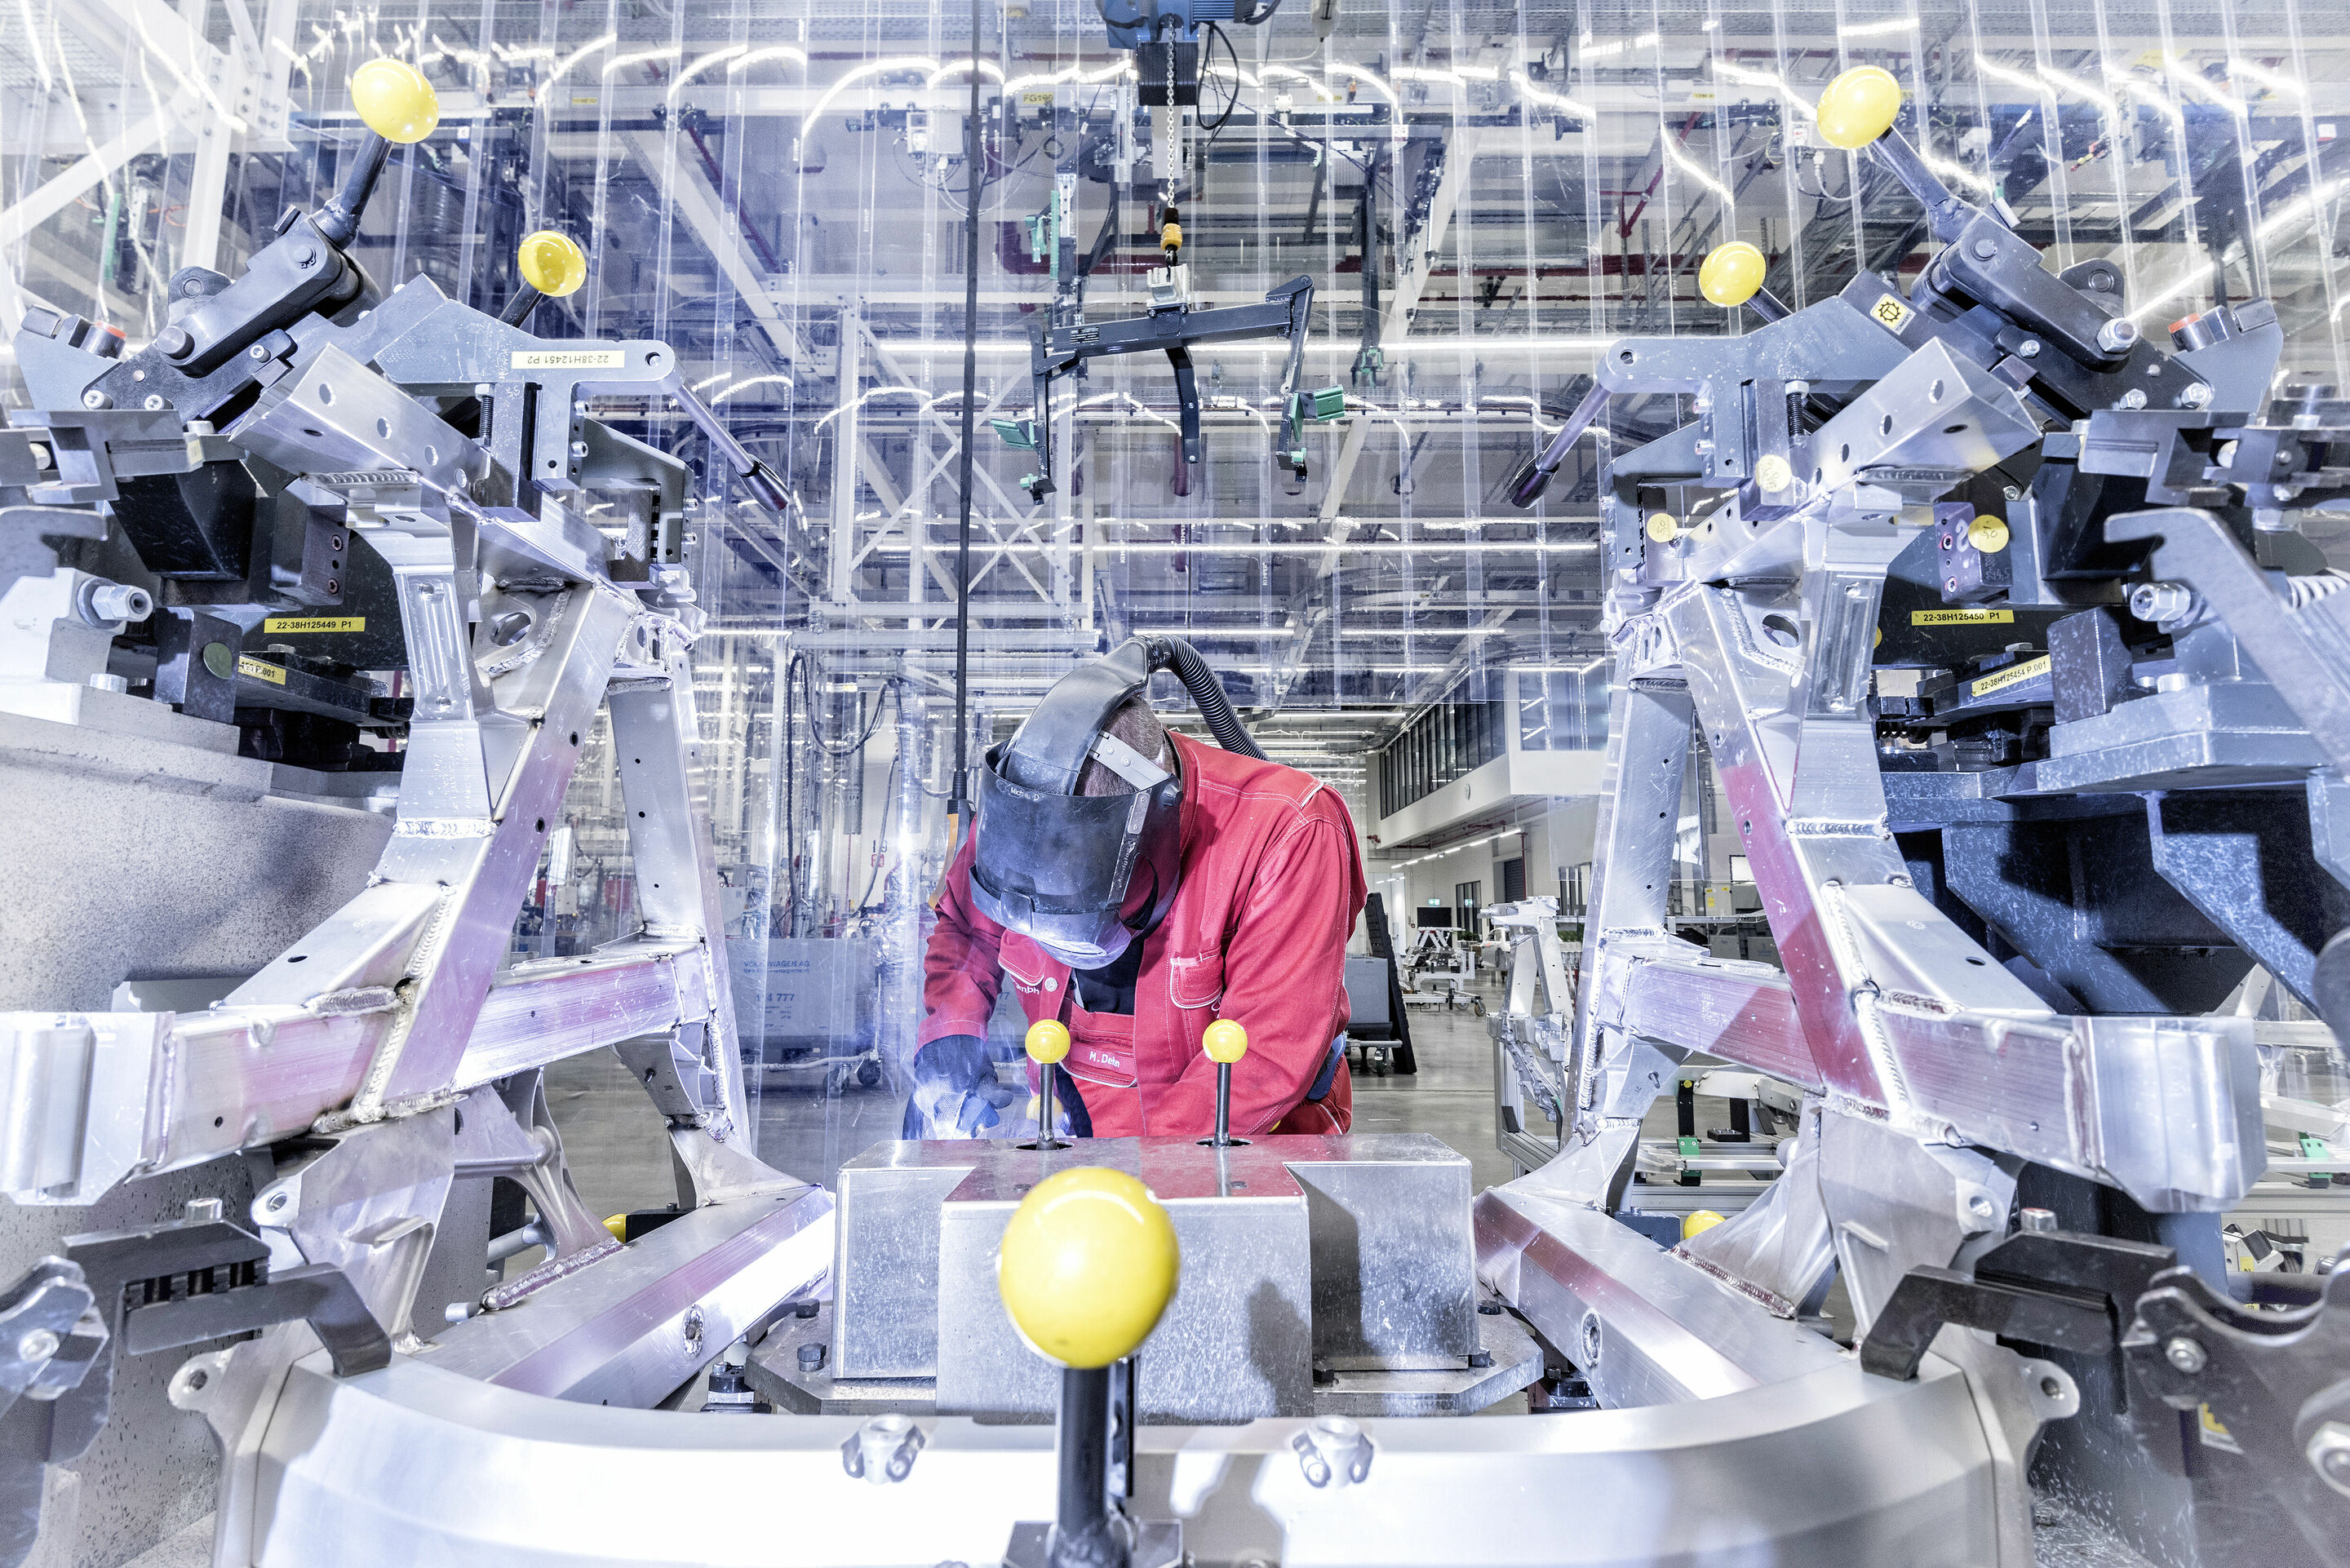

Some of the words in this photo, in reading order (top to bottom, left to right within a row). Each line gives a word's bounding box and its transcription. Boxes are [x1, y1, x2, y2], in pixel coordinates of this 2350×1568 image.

[527, 356, 540, 364] P2
[544, 355, 610, 364] 22-38H12451
[1923, 613, 1984, 622] 22-38H125450
[1989, 612, 2000, 620] P1
[277, 621, 336, 629] 22-38H125449
[1980, 669, 2025, 691] 22-38H125454
[777, 993, 795, 1002] 777
